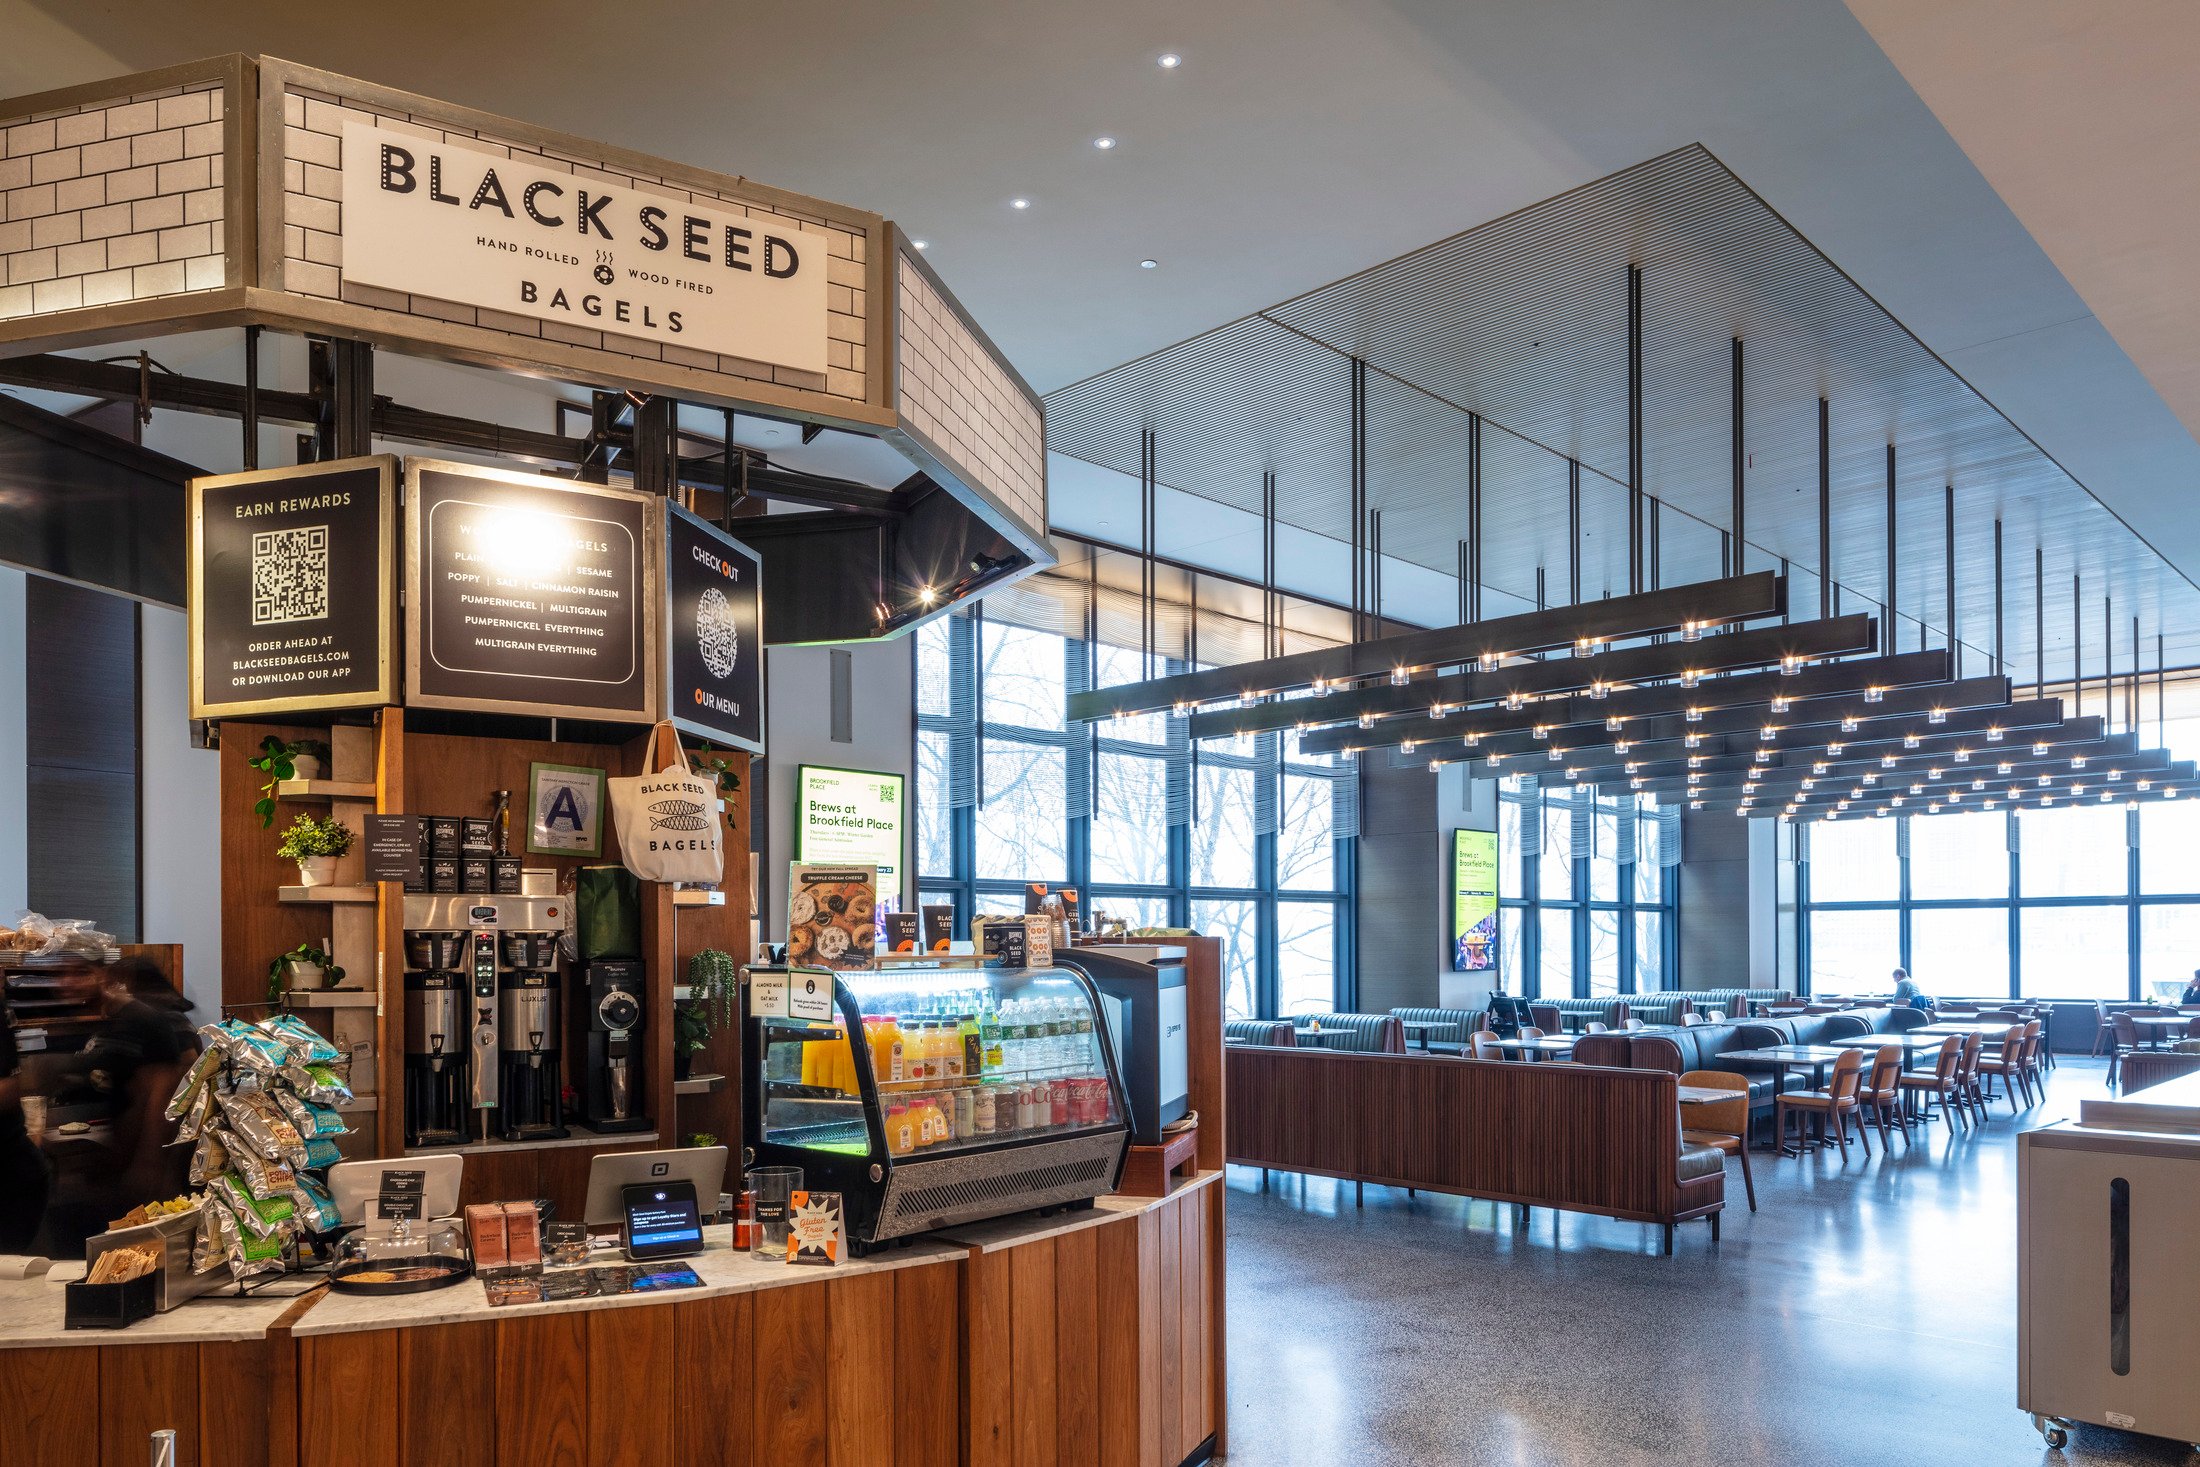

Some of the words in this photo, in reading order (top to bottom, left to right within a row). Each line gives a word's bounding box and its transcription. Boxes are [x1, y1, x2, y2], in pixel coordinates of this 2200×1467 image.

[380, 142, 615, 241] BLACK
[639, 205, 800, 280] SEED
[476, 236, 518, 255] HAND
[525, 246, 579, 266] ROLLED
[628, 268, 670, 286] WOOD
[675, 279, 714, 295] FIRED
[520, 280, 684, 333] BAGELS
[235, 502, 274, 518] EARN
[280, 492, 351, 513] REWARDS
[576, 566, 613, 578] SESAME
[692, 545, 722, 573] CHECK
[721, 560, 739, 582] OUT
[447, 572, 481, 583] POPPY
[495, 577, 518, 587] SALT
[531, 582, 586, 595] CINNAMON
[588, 588, 619, 598] RAISIN
[461, 594, 537, 610] PUMPERNICKEL
[549, 604, 607, 617] MULTIGRAIN
[465, 615, 541, 631] PUMPERNICKEL
[544, 623, 604, 637] EVERYTHING
[248, 640, 282, 652] ORDER
[285, 637, 318, 649] AHEAD
[321, 636, 333, 646] AT
[475, 637, 535, 651] MULTIGRAIN
[537, 643, 597, 656] EVERYTHING
[233, 651, 350, 670] BLACKSEEDBAGELS.COM
[232, 676, 246, 686] OR
[249, 671, 305, 685] DOWNLOAD
[308, 669, 329, 680] OUR
[332, 667, 351, 678] APP
[694, 688, 715, 709] OUR
[715, 695, 740, 717] MENU
[641, 783, 679, 794] BLACK
[682, 782, 704, 795] SEED
[545, 786, 583, 831] A
[810, 800, 841, 813] Brews
[845, 805, 856, 814] at
[810, 814, 864, 828] Brookfield
[867, 818, 893, 830] Place
[276, 1127, 297, 1135] POTA
[311, 1151, 336, 1159] CHIPS
[800, 1217, 826, 1228] Gluten
[803, 1226, 824, 1236] Free
